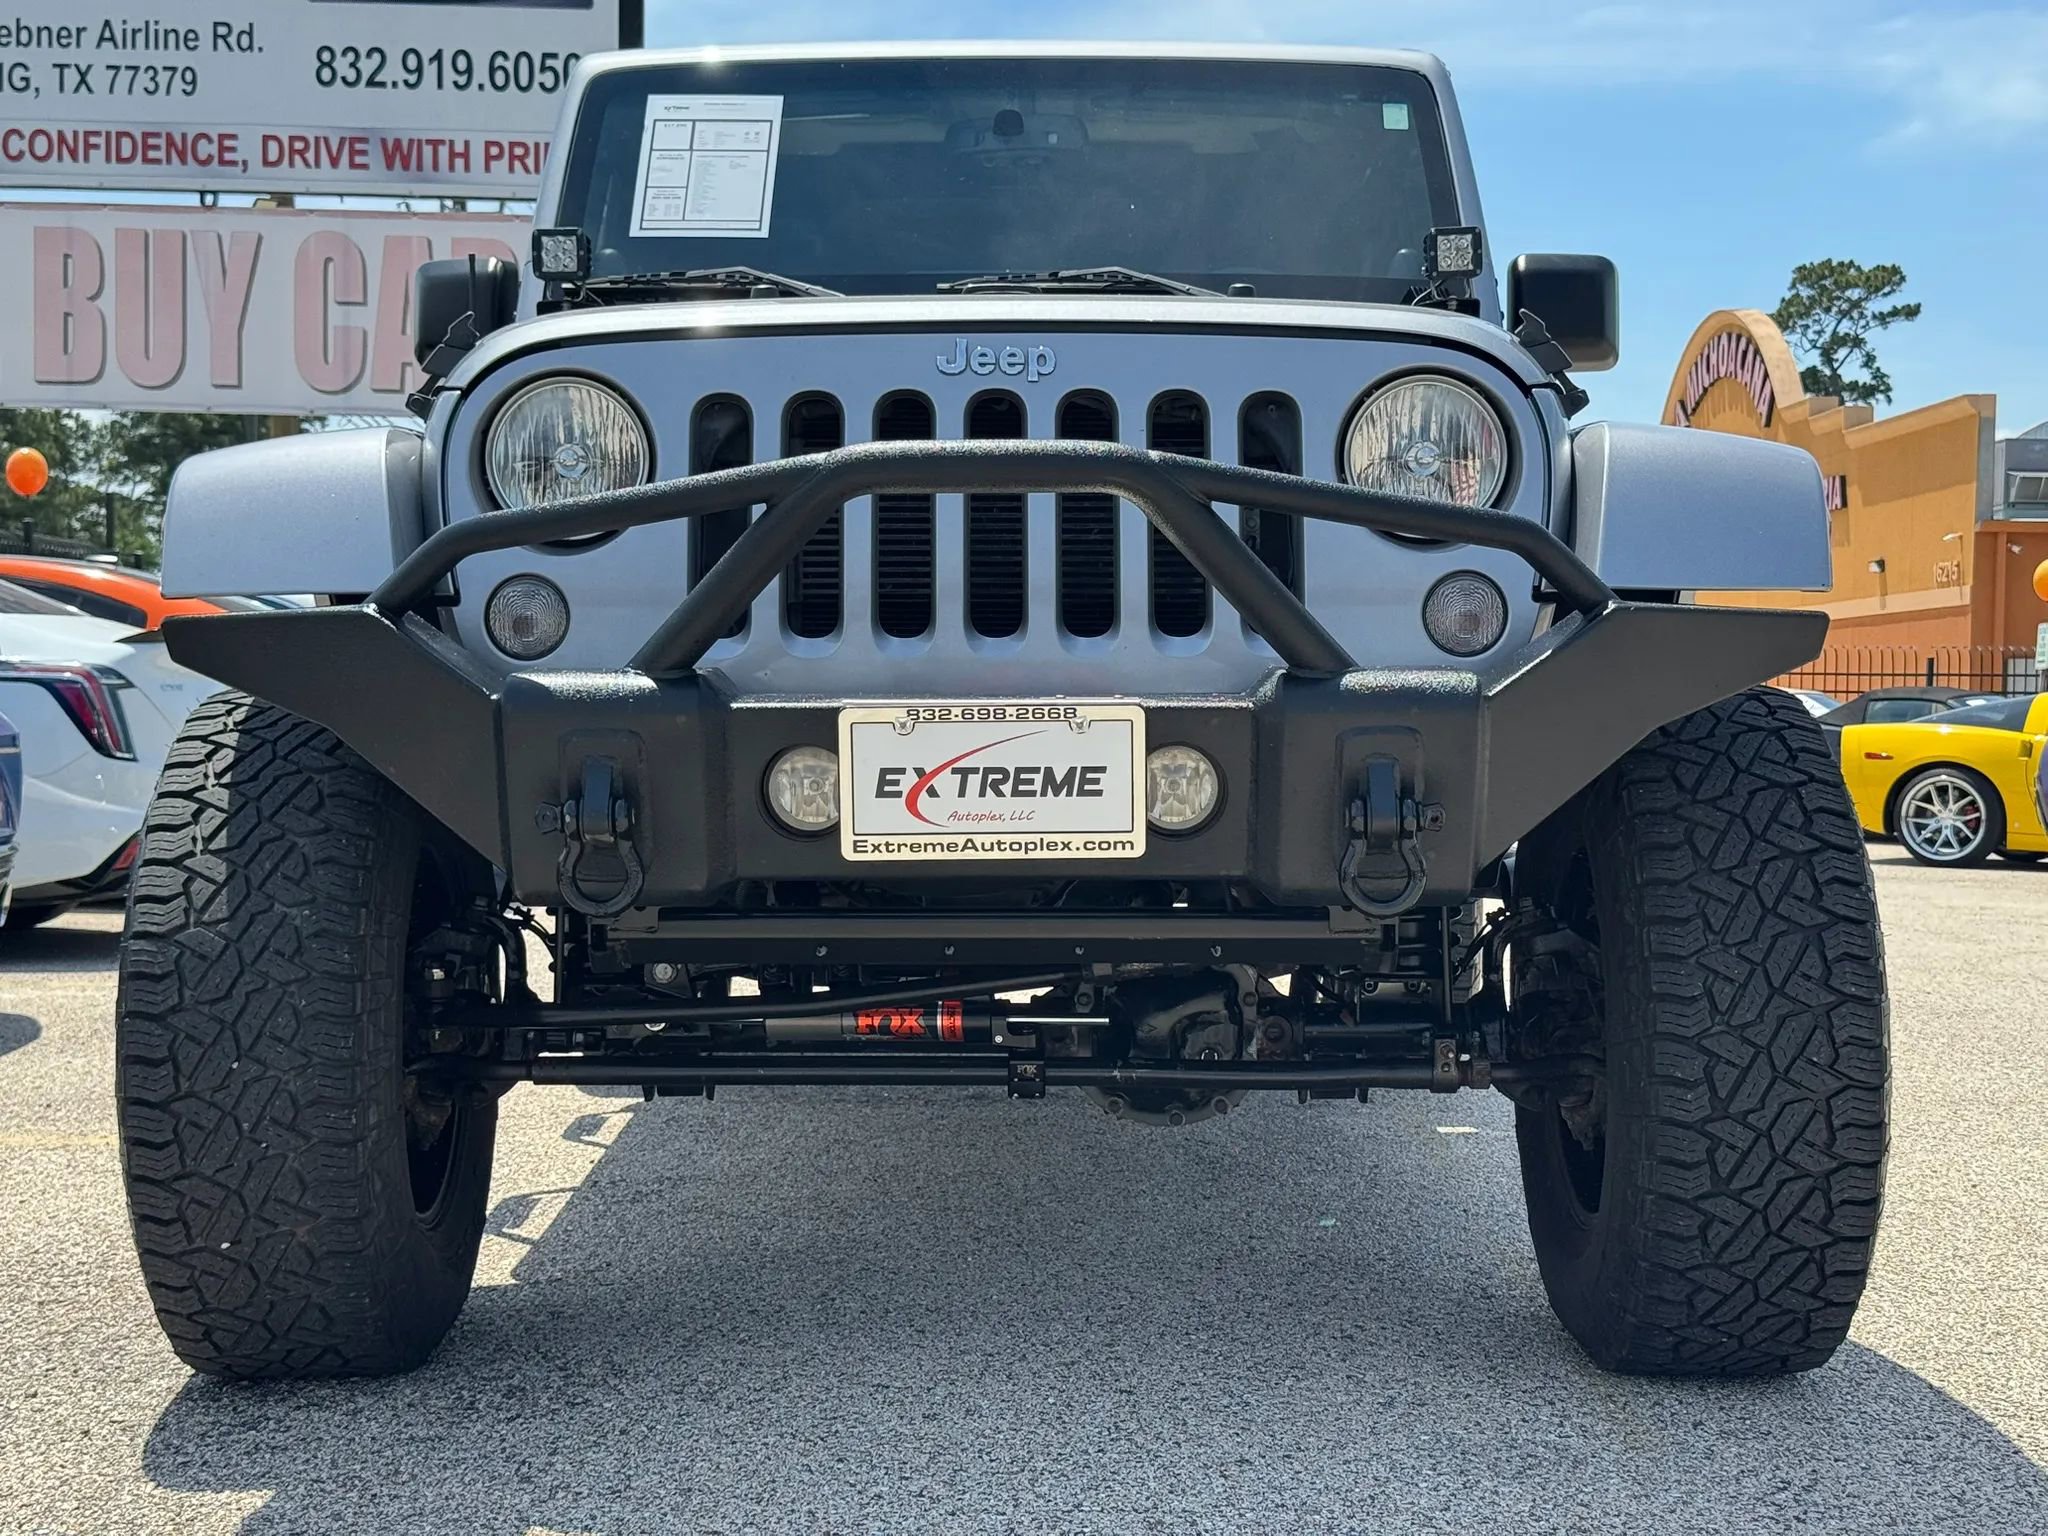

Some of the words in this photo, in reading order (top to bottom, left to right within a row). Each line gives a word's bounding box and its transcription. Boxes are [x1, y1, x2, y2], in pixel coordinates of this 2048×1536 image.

[0, 18, 87, 49] ebner
[96, 19, 200, 51] Airline
[212, 21, 264, 53] Rd.
[52, 63, 95, 95] TX
[105, 64, 198, 97] 77379
[2, 128, 249, 173] CONFIDENCE,
[262, 134, 369, 171] DRIVE
[380, 137, 470, 173] WITH
[484, 140, 551, 175] PRI
[34, 226, 263, 391] BUY
[294, 230, 518, 396] CA
[936, 337, 1057, 383] Jeep
[1686, 331, 1774, 428] MICHOACANA
[906, 707, 1078, 721] 832-698-2668
[875, 766, 1107, 798] EXTREME
[947, 810, 1005, 824] Autoplex,
[1009, 810, 1036, 822] LLC
[852, 838, 1134, 855] ExtremeAutoplex.com
